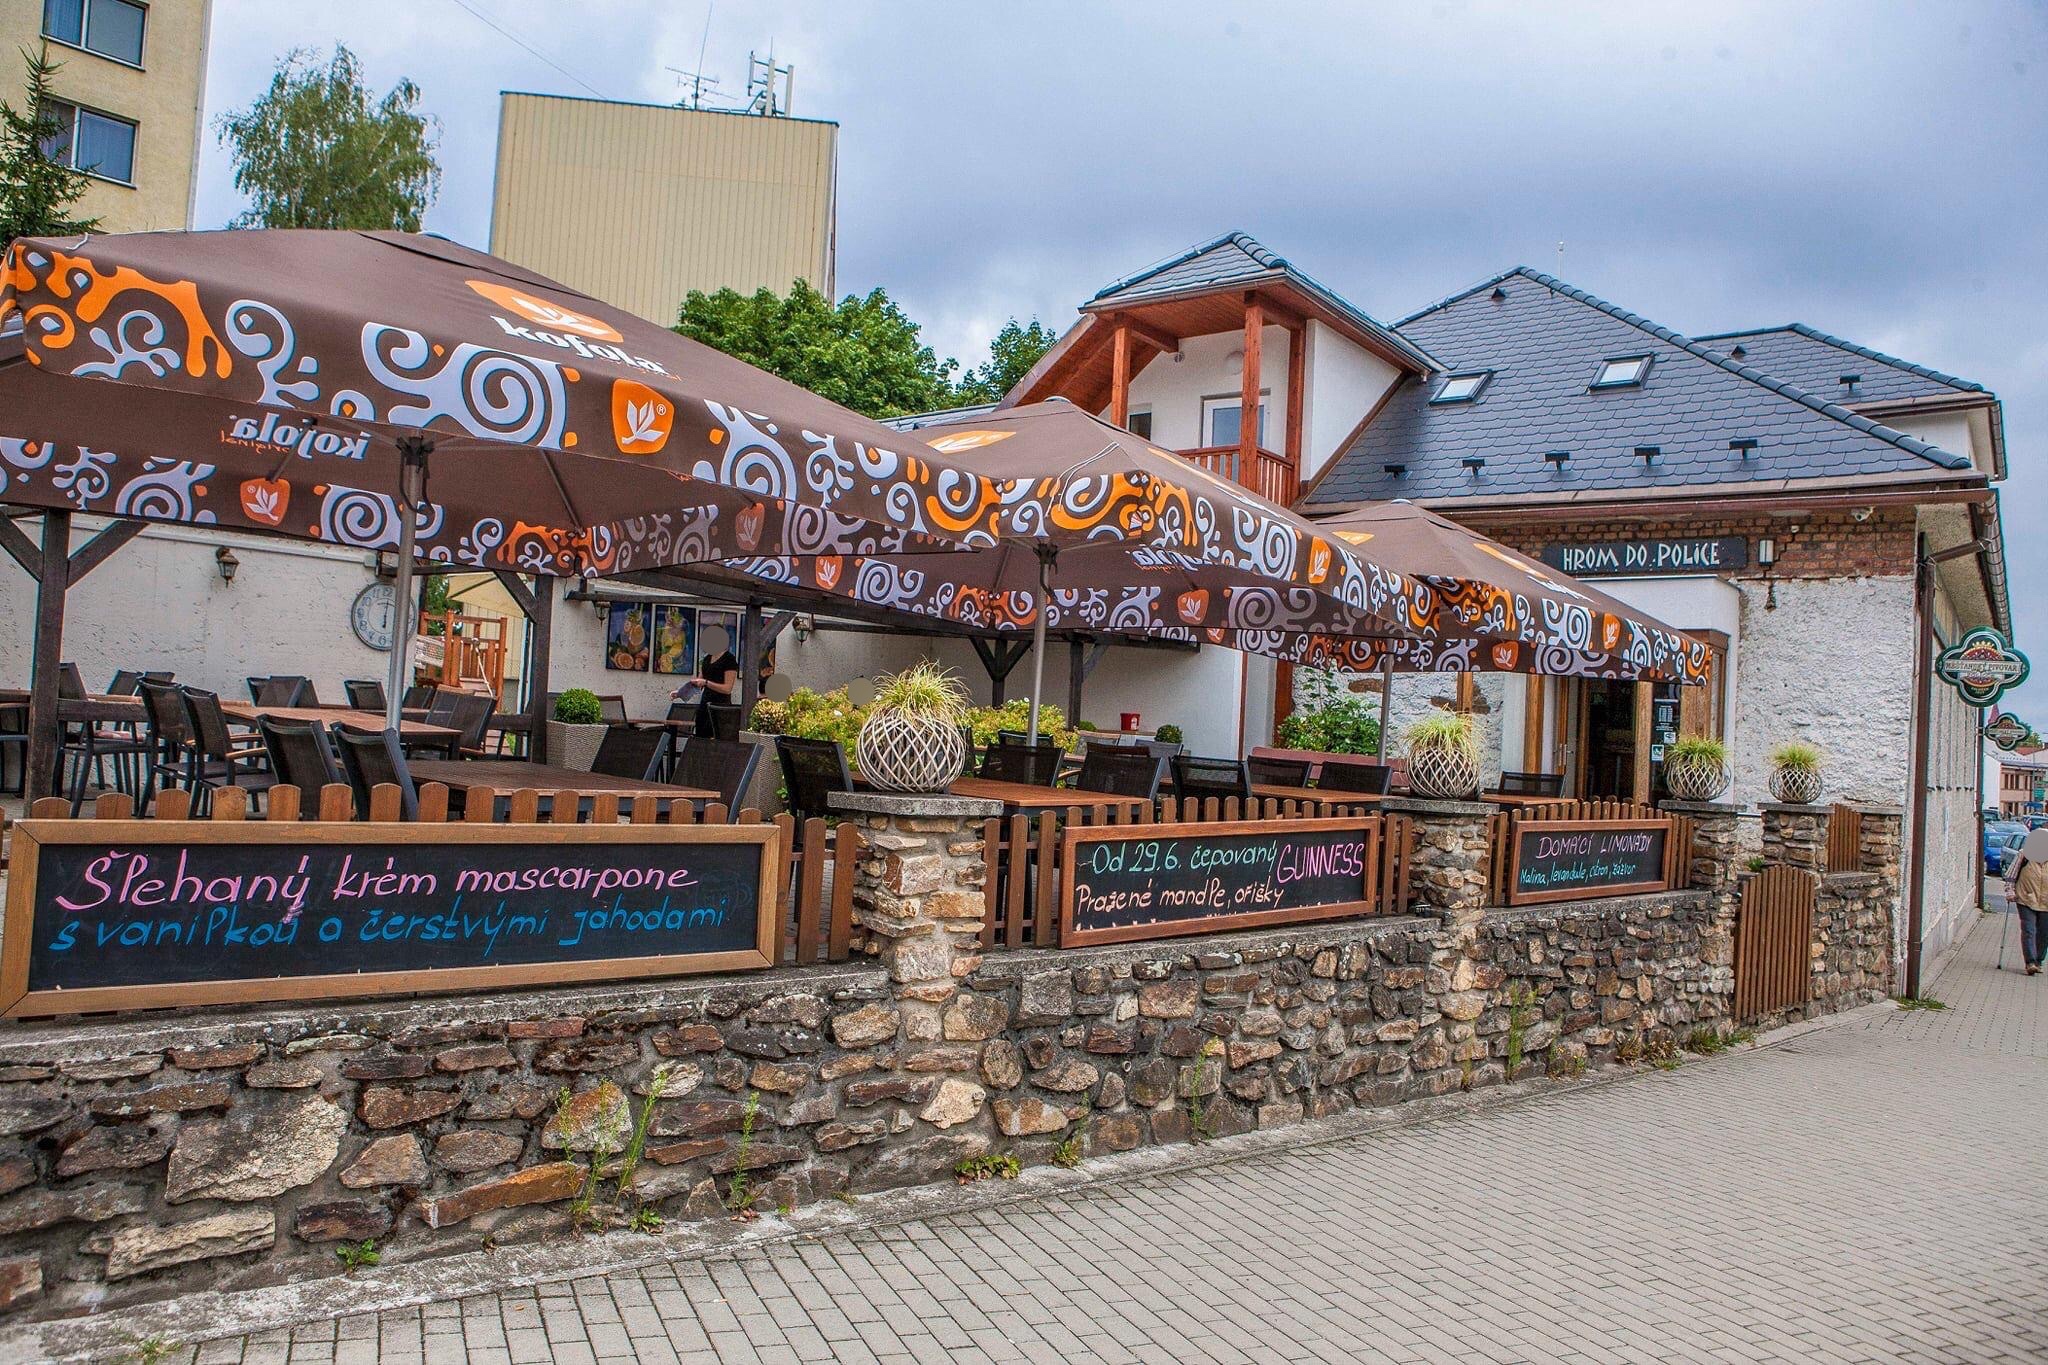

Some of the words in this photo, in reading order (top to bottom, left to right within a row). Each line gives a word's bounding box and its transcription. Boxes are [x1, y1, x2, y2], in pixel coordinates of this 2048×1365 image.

[490, 315, 669, 375] kofola
[1563, 546, 1619, 571] HROM
[1625, 544, 1648, 567] DO
[1988, 662, 2018, 672] PIVOVAR
[1091, 842, 1125, 875] Od
[1189, 839, 1278, 875] čepovaný
[1276, 842, 1365, 884] GUINNESS
[1535, 832, 1594, 859] DOMÁCÍ
[55, 848, 310, 924] Šlehaný
[332, 853, 436, 901] krém
[454, 864, 700, 900] mascarpone
[1075, 878, 1152, 915] Pražené
[49, 919, 81, 951] s
[97, 905, 298, 947] vanilkou
[318, 916, 343, 942] a
[359, 892, 551, 958] čerstvými
[558, 892, 730, 946] jahodami
